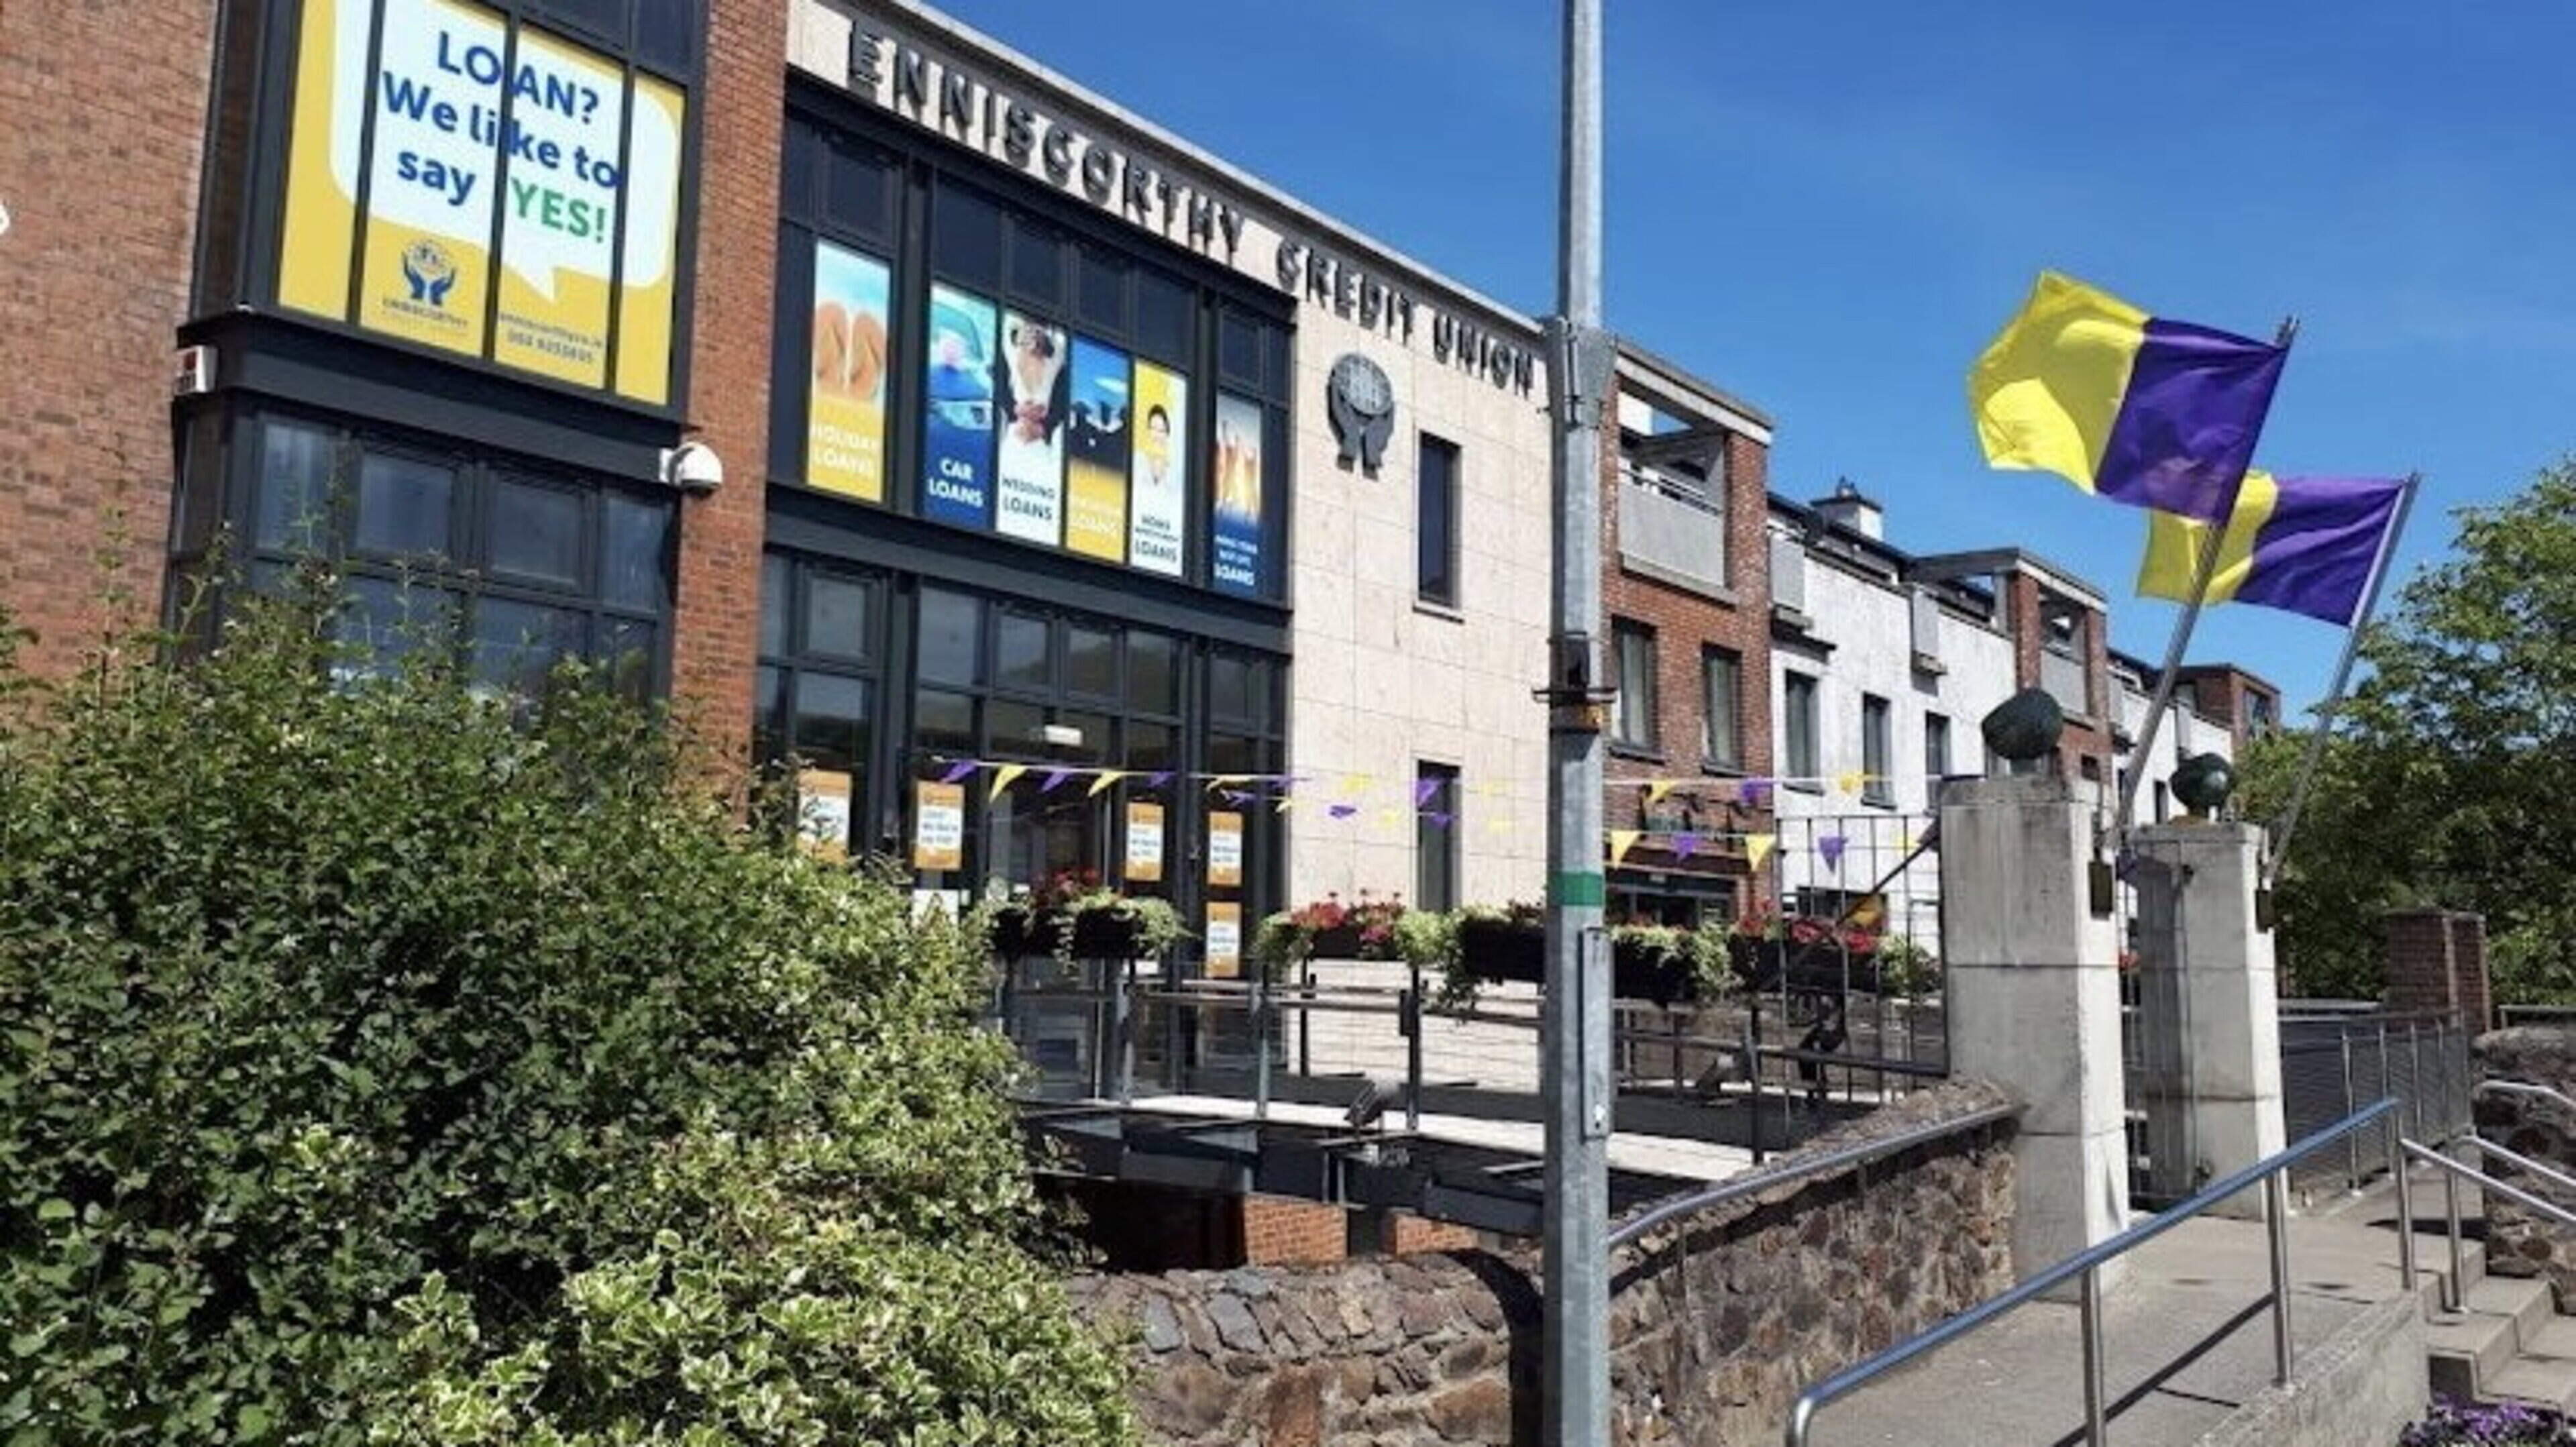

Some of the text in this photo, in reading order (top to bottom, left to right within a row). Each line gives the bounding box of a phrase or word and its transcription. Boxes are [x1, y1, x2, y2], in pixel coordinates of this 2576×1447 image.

[437, 30, 599, 125] LOAN?
[382, 70, 620, 189] We like to
[397, 150, 606, 244] say YES!
[851, 19, 1534, 398] ENNISCORTHY CREDIT UNION
[940, 457, 972, 480] CAR
[928, 477, 984, 508] LOANS
[1004, 493, 1053, 521] LOANS
[1135, 538, 1177, 563] LOANS
[1214, 562, 1255, 586] LOANS
